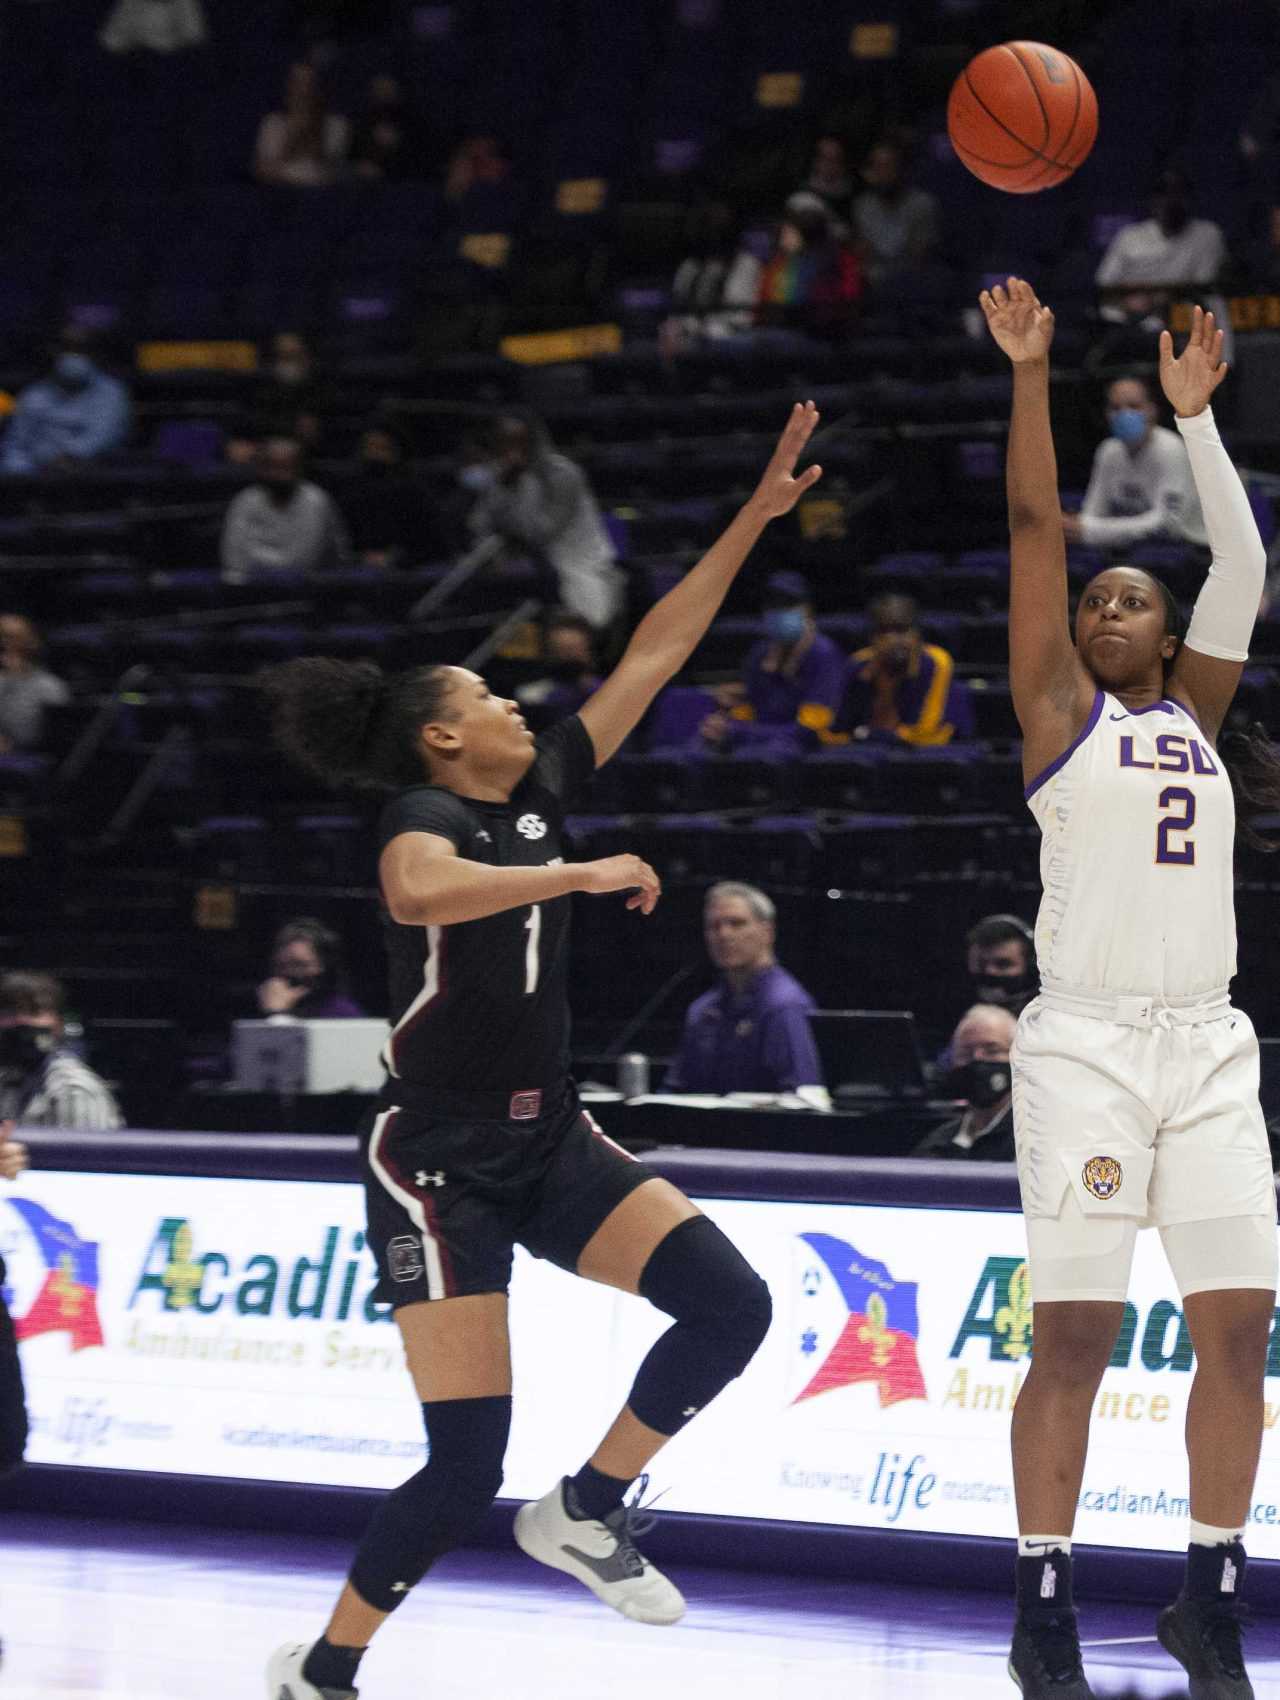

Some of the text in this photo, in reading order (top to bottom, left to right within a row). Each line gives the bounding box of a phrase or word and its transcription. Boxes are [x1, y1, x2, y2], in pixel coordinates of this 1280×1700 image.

[1118, 733, 1220, 777] LSU
[1155, 785, 1197, 867] 2
[523, 904, 542, 995] 1
[126, 1217, 395, 1323] Acadi
[944, 1367, 1171, 1424] Amnce
[867, 1451, 938, 1523] life
